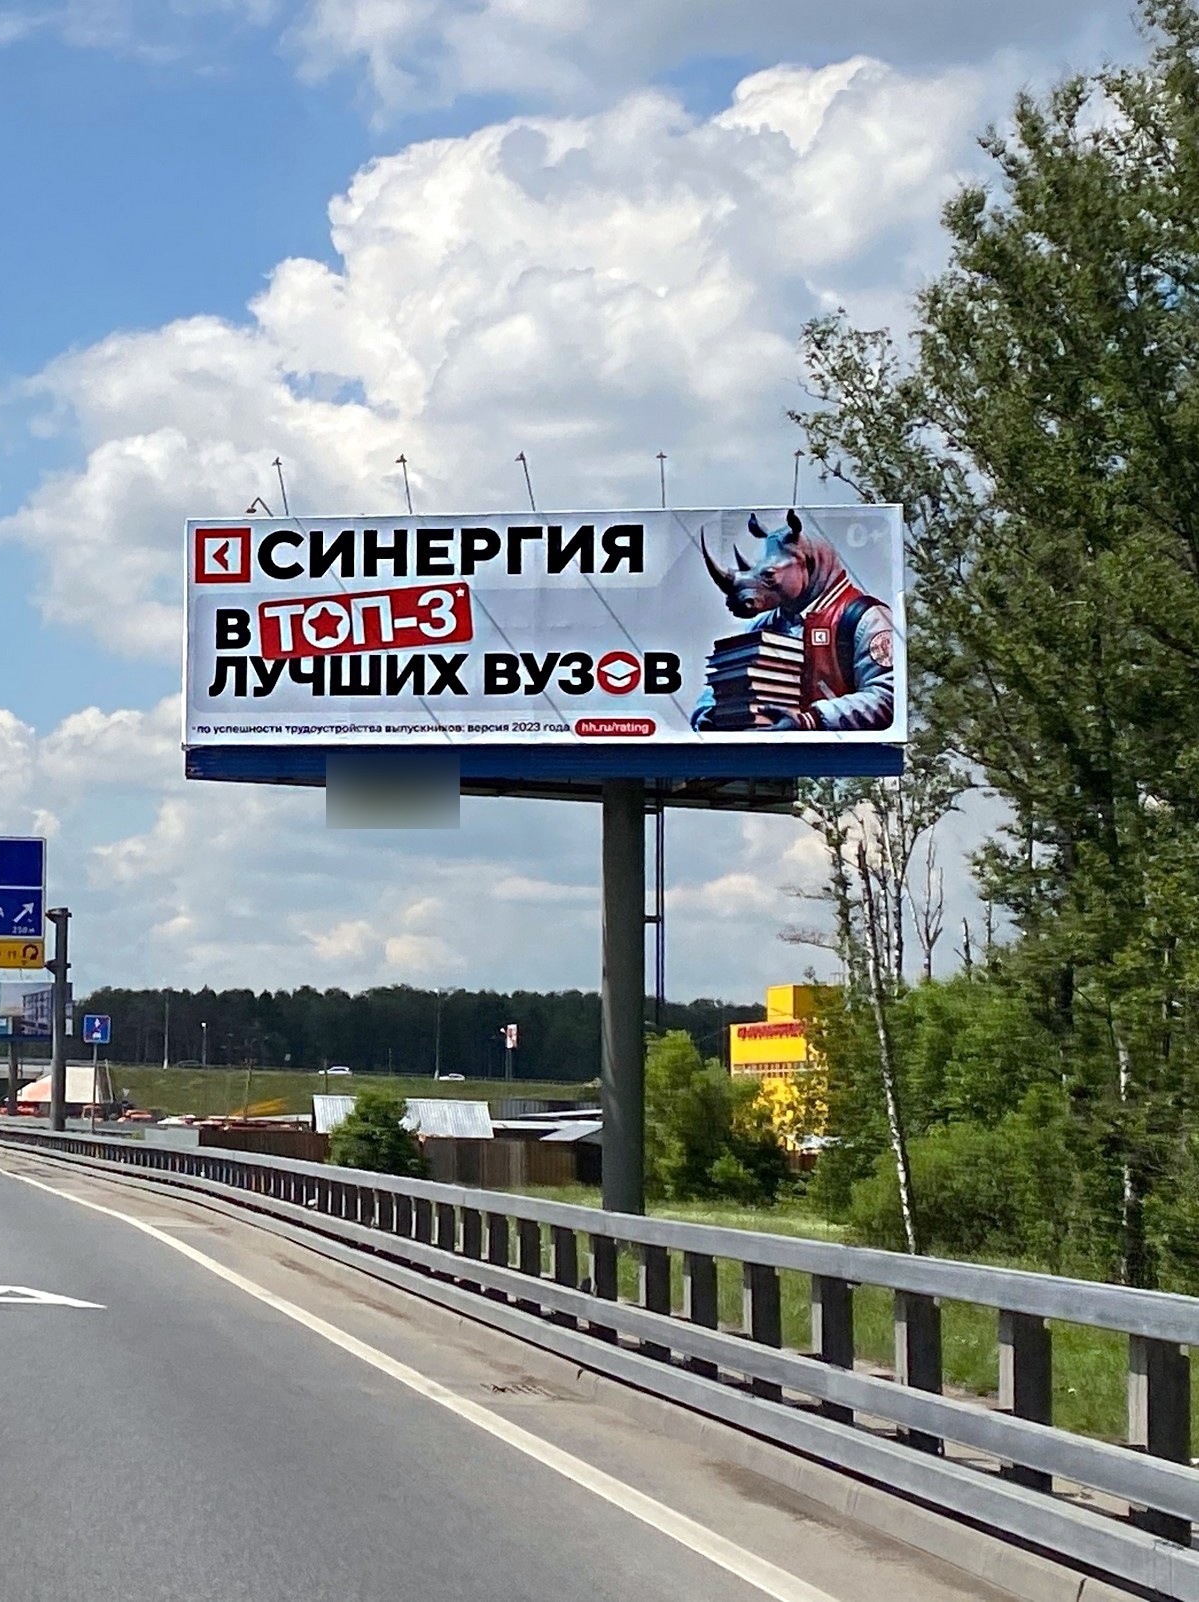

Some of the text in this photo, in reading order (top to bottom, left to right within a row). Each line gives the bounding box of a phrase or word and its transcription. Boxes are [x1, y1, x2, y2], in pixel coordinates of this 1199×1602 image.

[257, 524, 644, 580] СИНЕРГИЯ
[215, 608, 252, 650] В
[208, 650, 683, 698] ЛУЧШИХ ВУЗОВ
[213, 724, 282, 735] успешности
[285, 722, 382, 735] трудоустройства
[467, 724, 509, 733] версия
[511, 722, 541, 732] 2023
[543, 723, 571, 733] года
[581, 721, 650, 735] hh.ru/rating
